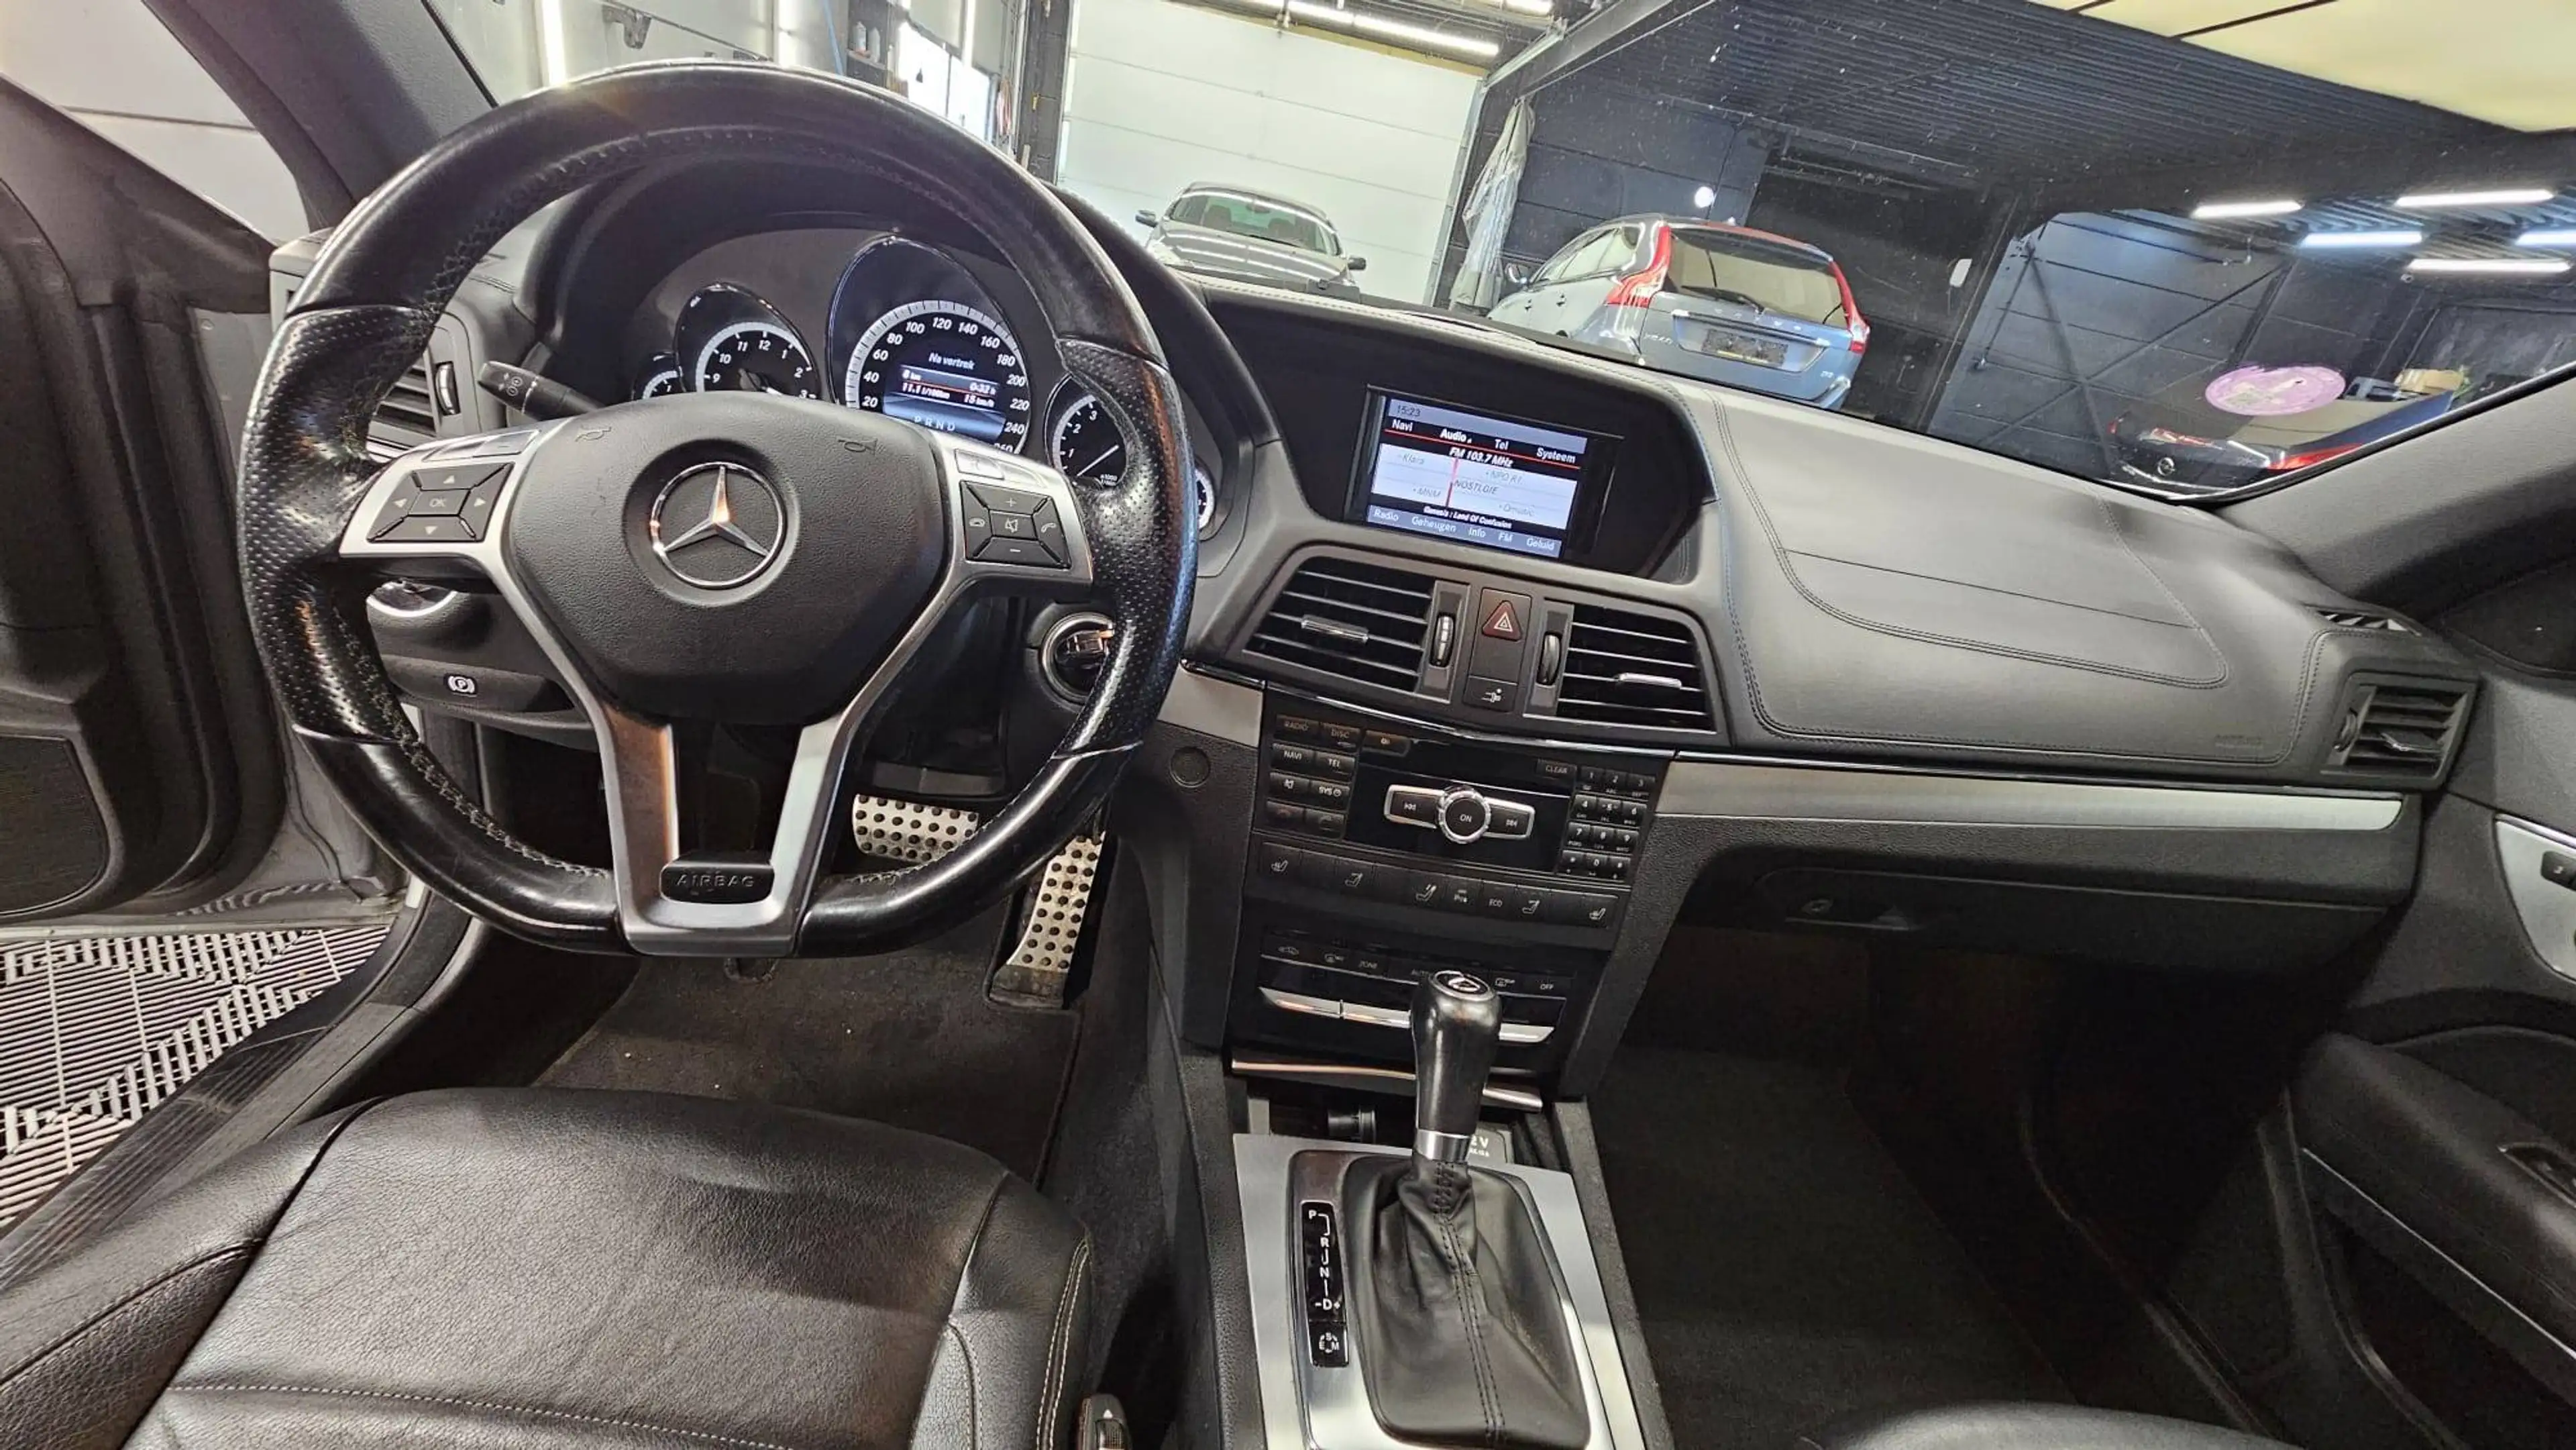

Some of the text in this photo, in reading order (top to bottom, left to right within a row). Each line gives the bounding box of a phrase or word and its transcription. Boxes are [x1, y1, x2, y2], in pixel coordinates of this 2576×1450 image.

[906, 321, 925, 334] 100
[932, 317, 952, 330] 120
[959, 321, 978, 335] 140
[887, 333, 902, 345] 80
[981, 335, 1000, 349] 160
[738, 341, 748, 352] 11
[758, 340, 771, 351] 12
[719, 354, 731, 364] 10
[782, 349, 788, 358] 1
[873, 349, 888, 361] 60
[997, 354, 1016, 366] 180
[712, 373, 720, 383] 9
[794, 367, 804, 378] 2
[863, 371, 879, 383] 40
[1007, 374, 1026, 386] 200
[861, 396, 878, 408] 20
[1010, 398, 1030, 411] 220
[1089, 411, 1097, 421] 3
[1397, 405, 1421, 417] 15:23
[1004, 421, 1025, 435] 240
[1073, 423, 1081, 433] 2
[1392, 419, 1576, 464] Navi Audio Tel Systeem
[1068, 448, 1074, 458] 1
[1449, 447, 1513, 468] FM 103.7 MHz
[429, 497, 448, 509] OK
[1374, 508, 1555, 552] Radio Geheugen Info FM Geluid
[1331, 729, 1350, 739] DISC
[1283, 750, 1302, 760] NAVI
[1546, 765, 1568, 774] CLEAR
[1460, 814, 1472, 823] ON
[677, 874, 755, 888] AIRBAG
[1489, 898, 1503, 907] ECO
[1540, 983, 1554, 991] OFF
[1309, 1210, 1317, 1220] P
[1320, 1237, 1330, 1247] R
[1320, 1267, 1330, 1278] N
